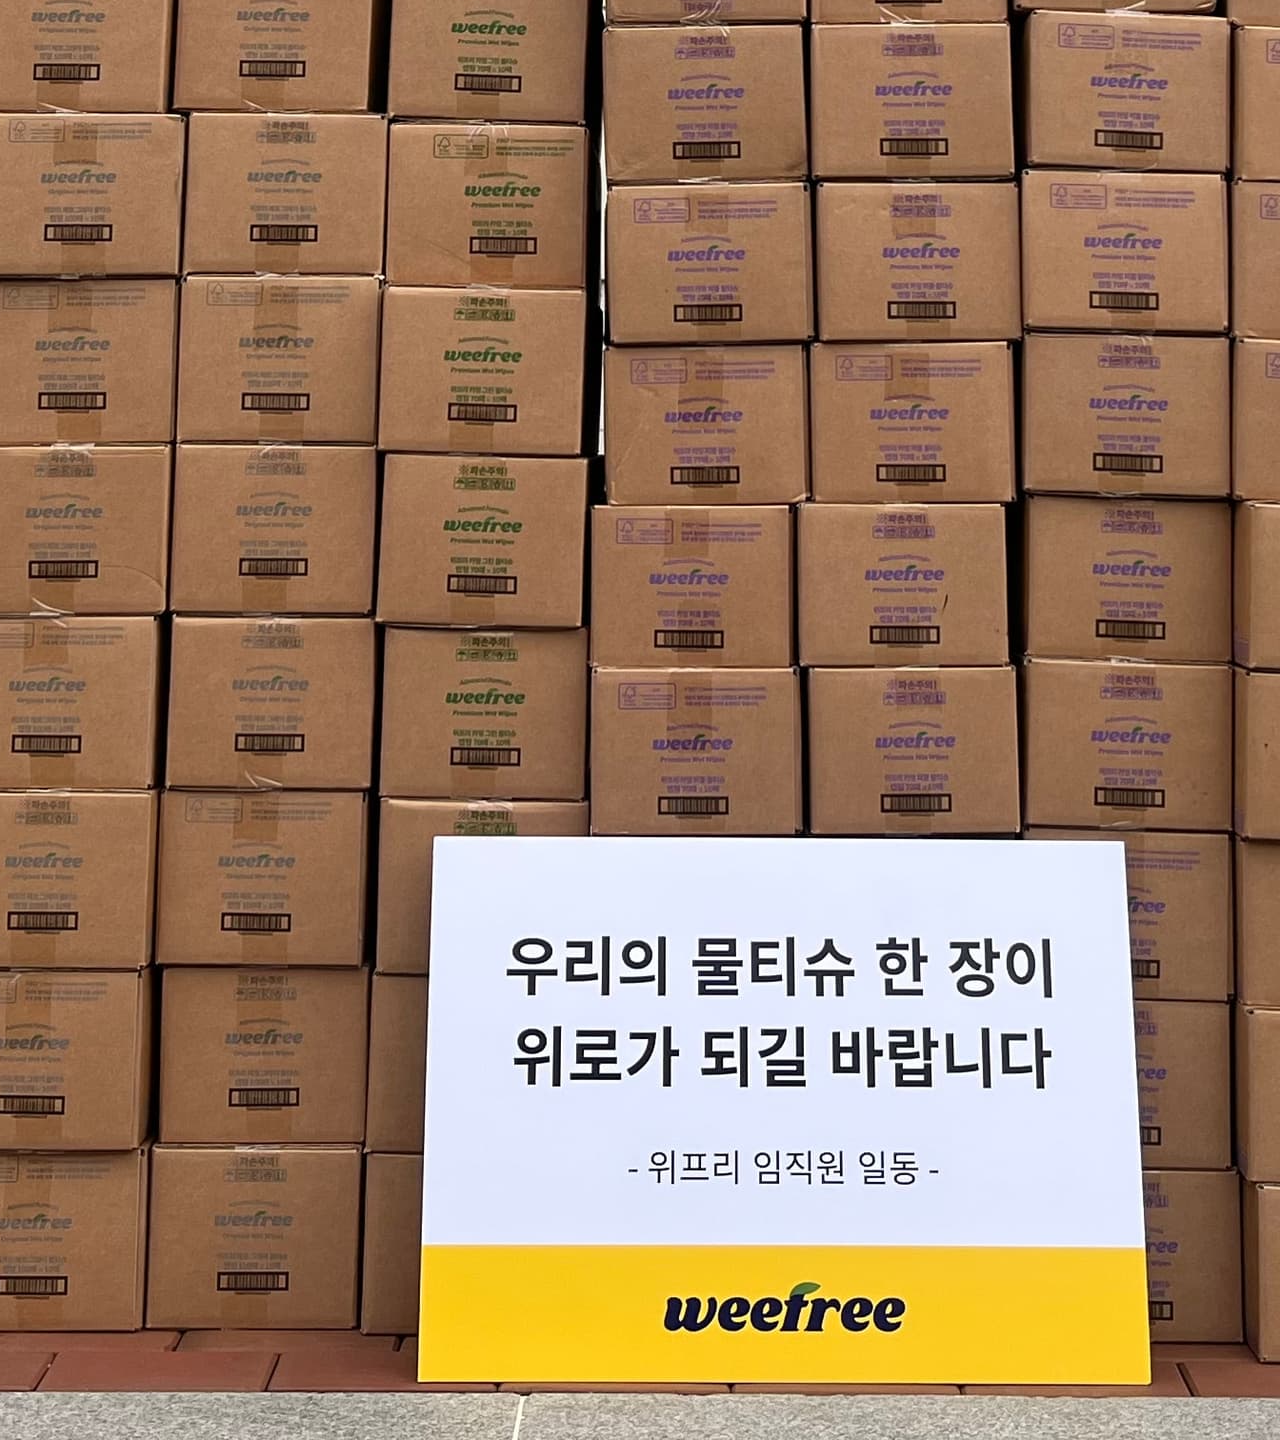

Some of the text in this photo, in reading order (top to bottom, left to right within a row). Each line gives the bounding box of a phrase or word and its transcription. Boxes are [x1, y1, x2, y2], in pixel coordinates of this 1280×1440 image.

[32, 8, 105, 23] weefree
[237, 7, 310, 22] weefree
[451, 20, 527, 35] weefree
[875, 81, 952, 98] weefree
[1090, 73, 1168, 90] weefree
[668, 84, 744, 101] weefree
[41, 169, 116, 184] weefree
[247, 168, 322, 183] weefree
[464, 182, 541, 197] weefree
[1084, 233, 1163, 250] weefree
[668, 245, 746, 263] weefree
[882, 243, 960, 260] weefree
[35, 336, 110, 351] weefree
[239, 333, 314, 348] weefree
[444, 347, 522, 364] weefree
[1089, 394, 1168, 412] weefree
[664, 407, 743, 424] weefree
[870, 404, 949, 422] weefree
[26, 503, 102, 520] weefree
[236, 501, 312, 518] weefree
[443, 516, 522, 534] weefree
[865, 565, 944, 583] weefree
[1093, 560, 1171, 578] weefree
[649, 569, 729, 587] weefree
[9, 676, 86, 693] weefree
[232, 675, 309, 692] weefree
[446, 688, 525, 706] weefree
[653, 734, 733, 752] weefree
[875, 732, 956, 750] weefree
[1091, 726, 1171, 745] weefree
[5, 852, 83, 869] weefree
[218, 852, 295, 869] weefree
[507, 936, 1052, 998] 우리의 물티슈 한 장이
[225, 1029, 302, 1046] weefree
[514, 1026, 1051, 1089] 위로가 되길 바랍니다
[648, 1150, 738, 1184] 위프리
[754, 1150, 844, 1185] 임직원
[859, 1151, 919, 1185] 일동
[215, 1210, 293, 1228] weefree
[664, 1282, 905, 1332] weefree
